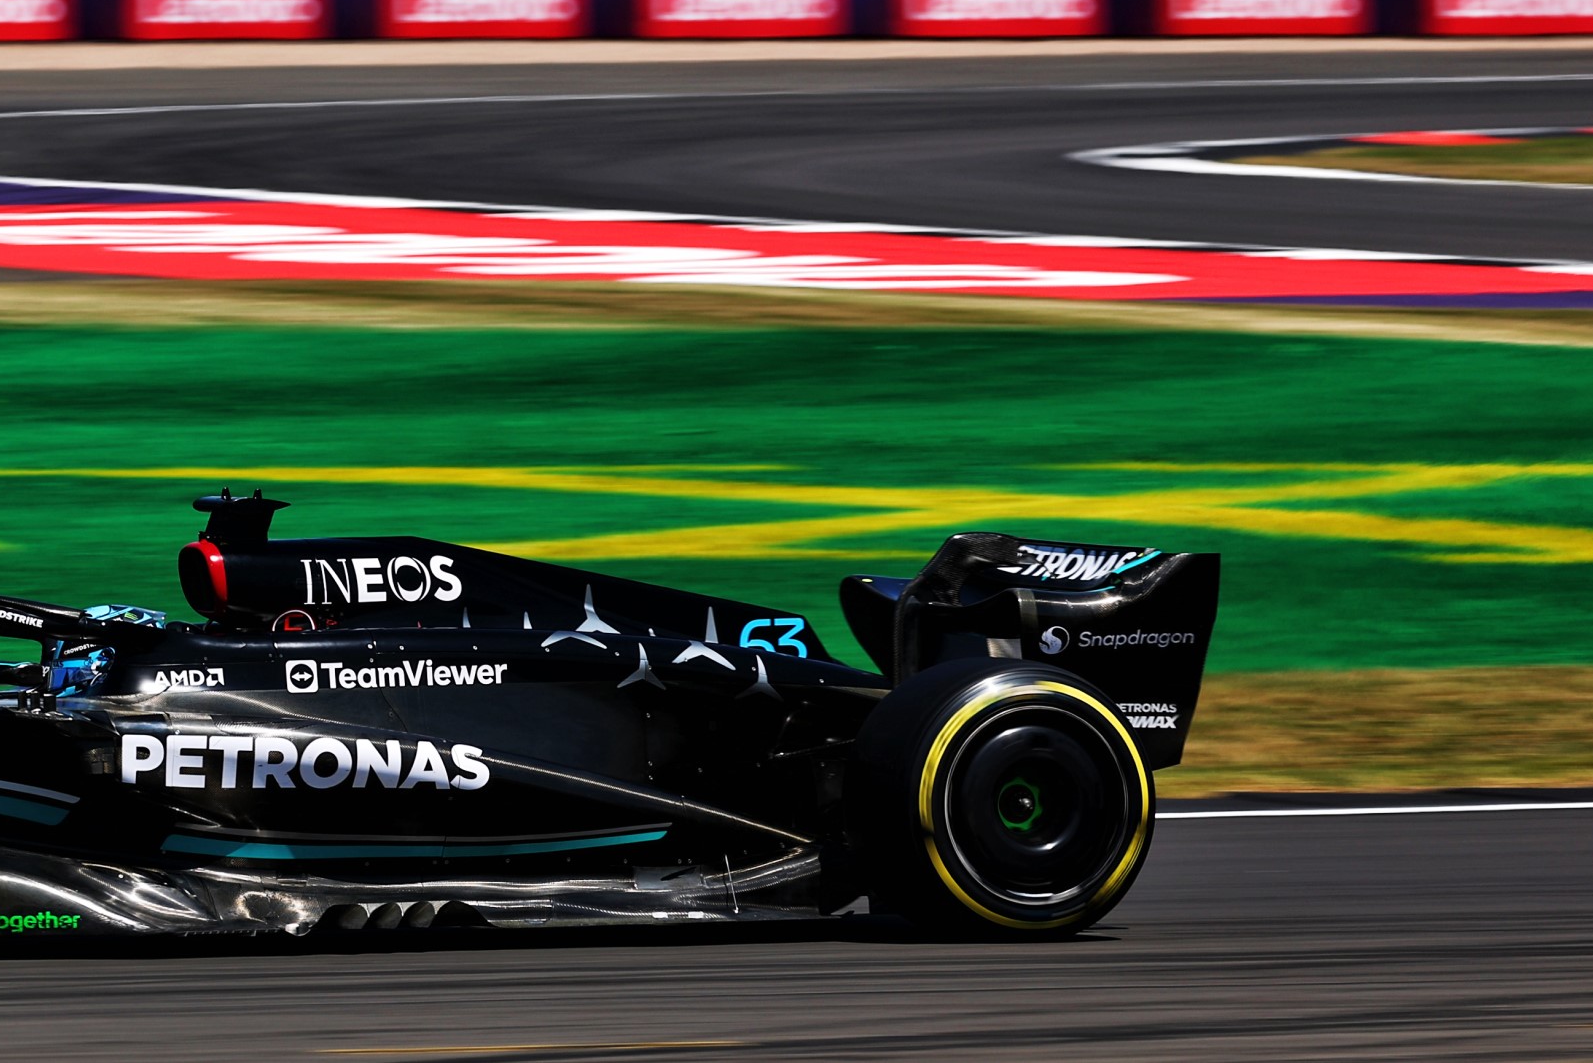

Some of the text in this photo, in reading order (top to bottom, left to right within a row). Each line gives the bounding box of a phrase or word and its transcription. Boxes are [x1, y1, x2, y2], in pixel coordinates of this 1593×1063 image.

[300, 555, 463, 605] INEOS
[1078, 629, 1195, 650] Snapdragon
[154, 669, 205, 687] AMD
[320, 659, 508, 689] TeamViewer
[121, 734, 491, 791] PETRONAS
